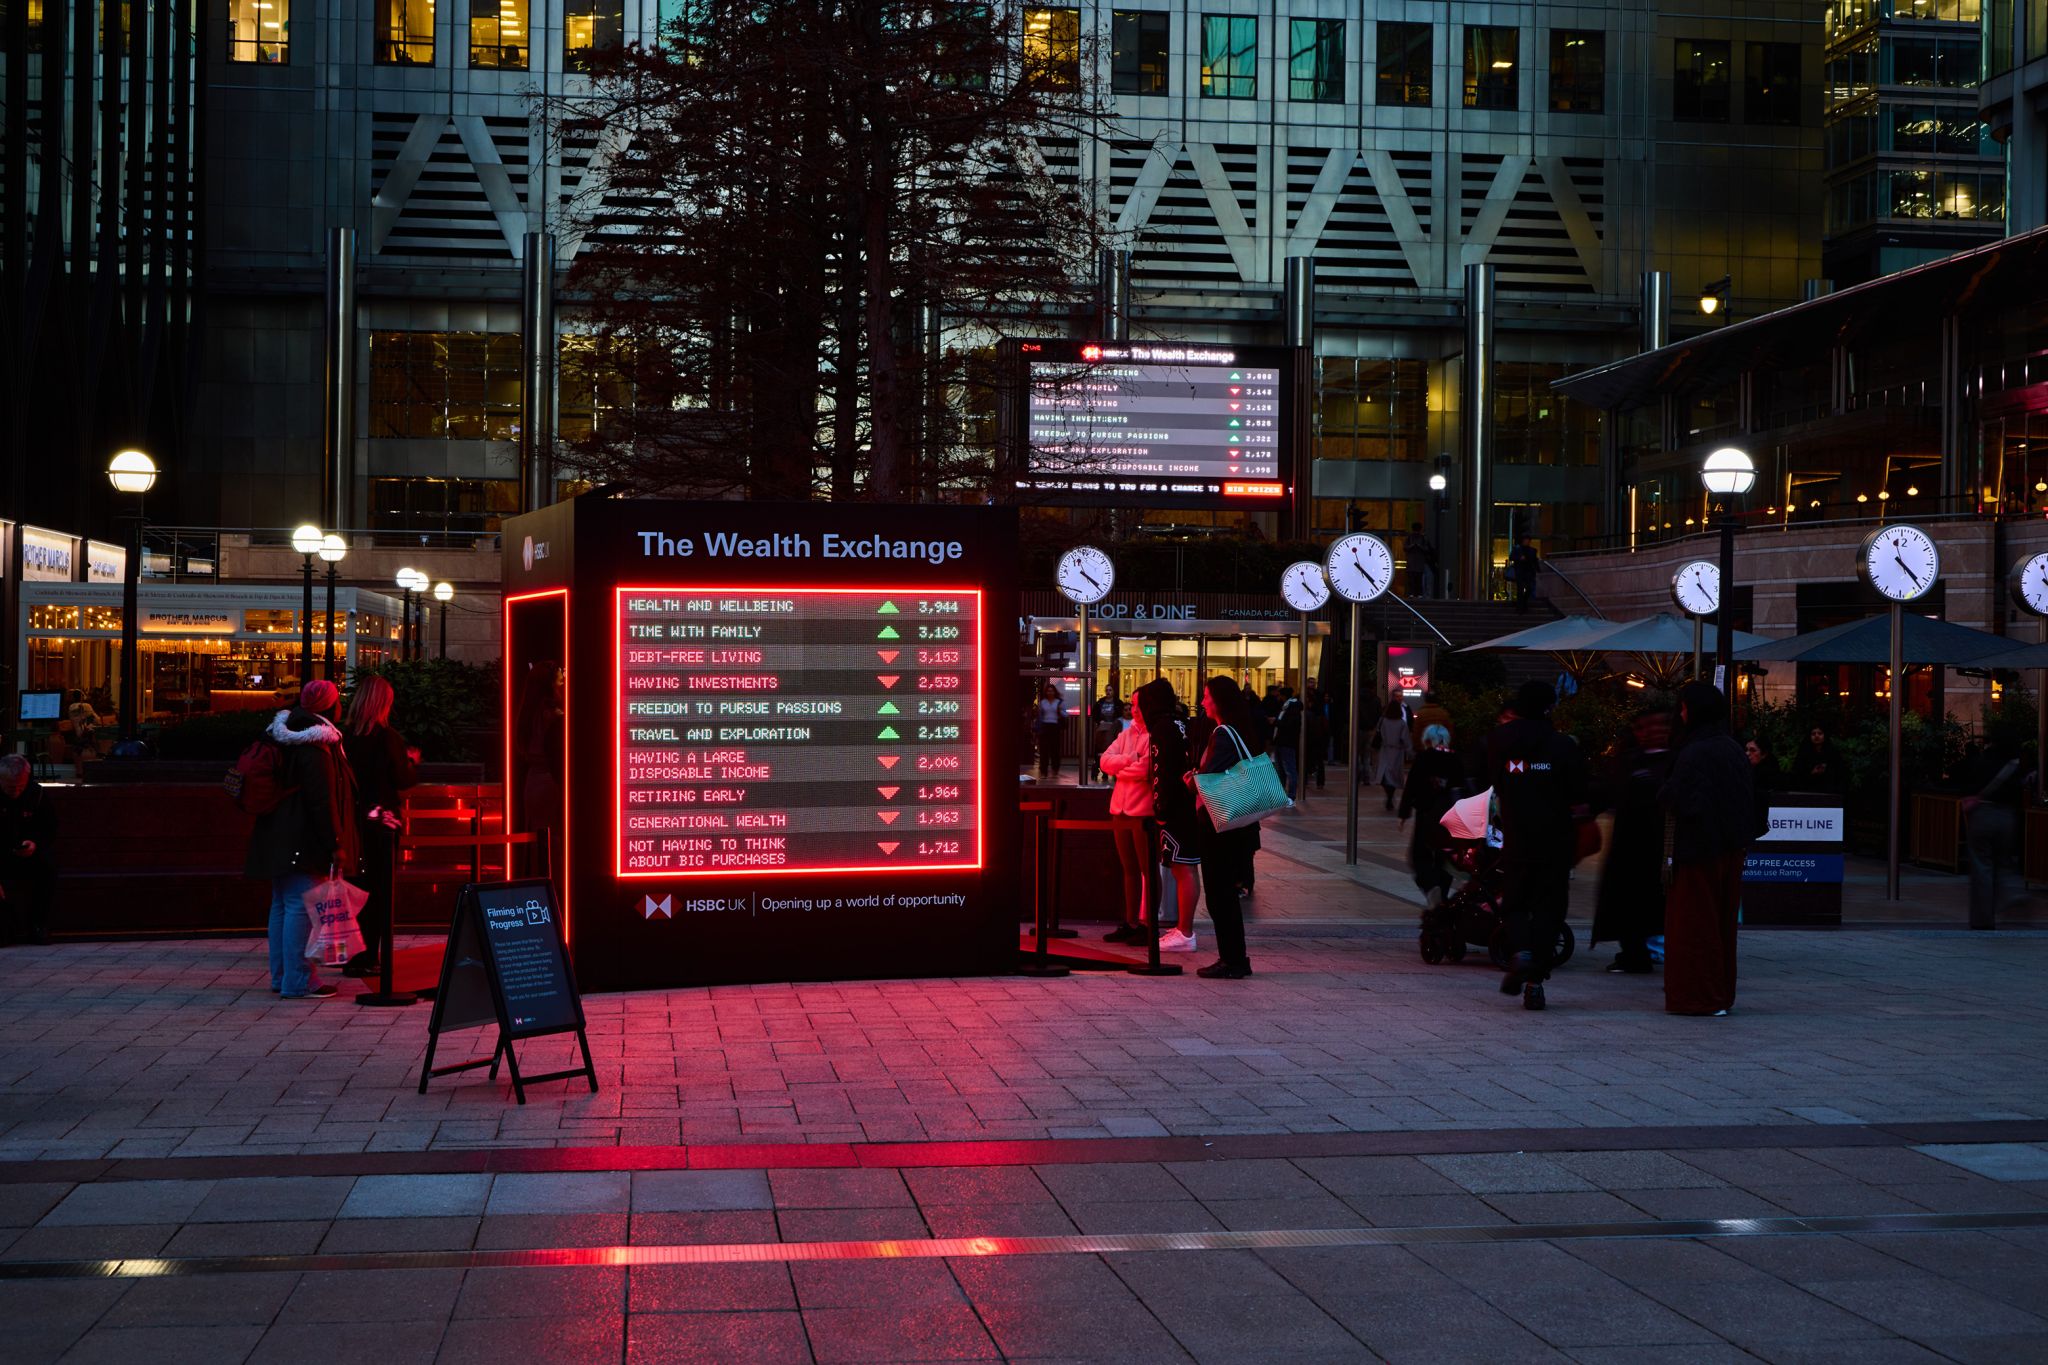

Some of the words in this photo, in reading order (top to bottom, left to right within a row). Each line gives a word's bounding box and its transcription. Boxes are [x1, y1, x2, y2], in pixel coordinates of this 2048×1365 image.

[1131, 346, 1150, 360] The
[1152, 348, 1185, 361] Wealth
[1187, 350, 1235, 364] Exchange
[638, 531, 694, 556] The
[704, 532, 811, 557] Wealth
[823, 533, 963, 564] Exchange
[628, 599, 680, 611] HEALTH
[687, 600, 712, 611] AND
[720, 600, 794, 612] WELLBEING
[918, 601, 959, 615] 3,944
[1074, 604, 1128, 619] SHOP
[1134, 605, 1147, 619] &
[1153, 605, 1197, 620] DINE
[1229, 609, 1263, 617] CANADA
[629, 625, 663, 637] TIME
[670, 626, 704, 637] WITH
[711, 626, 761, 637] FAMILY
[918, 626, 959, 639] 3,180
[629, 651, 704, 663] DEBT-FREE
[711, 651, 761, 663] LIVING
[918, 651, 959, 664] 3,153
[629, 677, 680, 689] HAVING
[688, 677, 778, 689] INVESTMENTS
[918, 677, 959, 689] 2,539
[629, 703, 688, 714] FREEDOM
[696, 703, 712, 714] TO
[720, 702, 770, 714] PURSUE
[777, 702, 842, 714] PASSIONS
[918, 701, 959, 714] 2,340
[629, 729, 680, 741] TRAVEL
[687, 729, 712, 740] AND
[720, 728, 810, 740] EXPLORATION
[918, 726, 959, 739] 2,195
[629, 752, 680, 764] HAVING
[687, 752, 696, 763] A
[704, 751, 745, 763] LARGE
[918, 756, 959, 769] 2,006
[629, 767, 712, 779] DISPOSABLE
[721, 766, 769, 778] INCOME
[1530, 762, 1551, 770] HSBC
[629, 790, 696, 803] RETIRING
[704, 790, 745, 802] EARLY
[919, 787, 959, 799] 1,964
[629, 816, 728, 828] GENERATIONAL
[736, 815, 786, 827] WEALTH
[919, 811, 959, 825] 1,963
[1807, 820, 1833, 829] LINE
[629, 840, 654, 852] NOT
[662, 839, 712, 851] HAVING
[720, 839, 737, 850] TO
[745, 838, 786, 850] THINK
[919, 842, 959, 854] 1,712
[629, 855, 670, 867] ABOUT
[679, 855, 704, 866] BIG
[711, 854, 786, 866] PURCHASES
[1743, 859, 1758, 867] TEP
[1780, 869, 1802, 877] Ramp
[686, 899, 725, 912] HSBC
[728, 898, 746, 910] UK
[761, 897, 812, 912] Opening
[816, 898, 832, 910] up
[835, 898, 843, 908] a
[845, 896, 880, 908] world
[883, 894, 895, 906] of
[898, 893, 966, 908] opportunity
[487, 907, 515, 918] Filming
[517, 906, 524, 914] in
[490, 920, 523, 930] Progress
